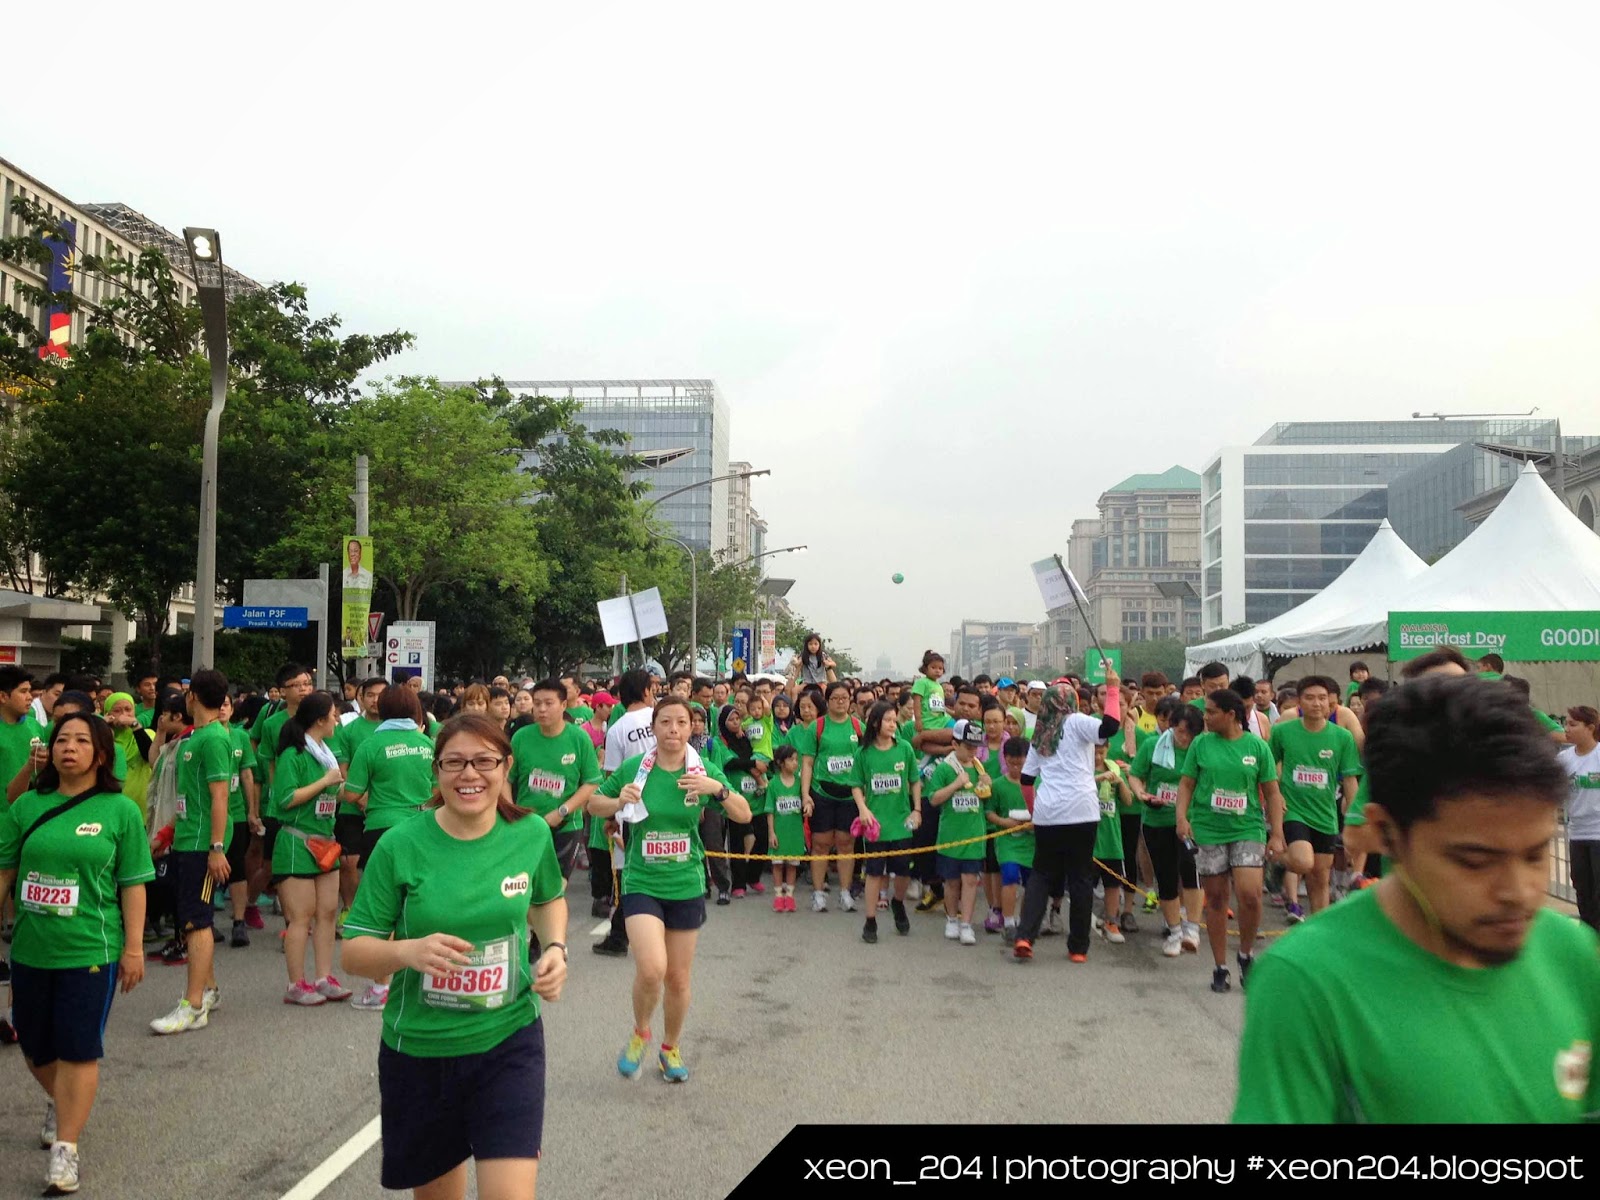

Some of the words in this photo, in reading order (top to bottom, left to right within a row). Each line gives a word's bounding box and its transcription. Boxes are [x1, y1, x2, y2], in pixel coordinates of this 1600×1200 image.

[242, 609, 266, 618] Jalan
[268, 609, 286, 618] P3F
[276, 620, 302, 628] Putrajaya
[1401, 624, 1448, 632] MALAYSIA
[1400, 632, 1471, 646] Breakfast
[1475, 632, 1506, 649] Day
[1540, 628, 1599, 646] GOODI
[628, 727, 655, 742] CRE
[646, 841, 687, 855] D6380
[504, 880, 527, 892] MILO
[26, 884, 71, 905] E8223
